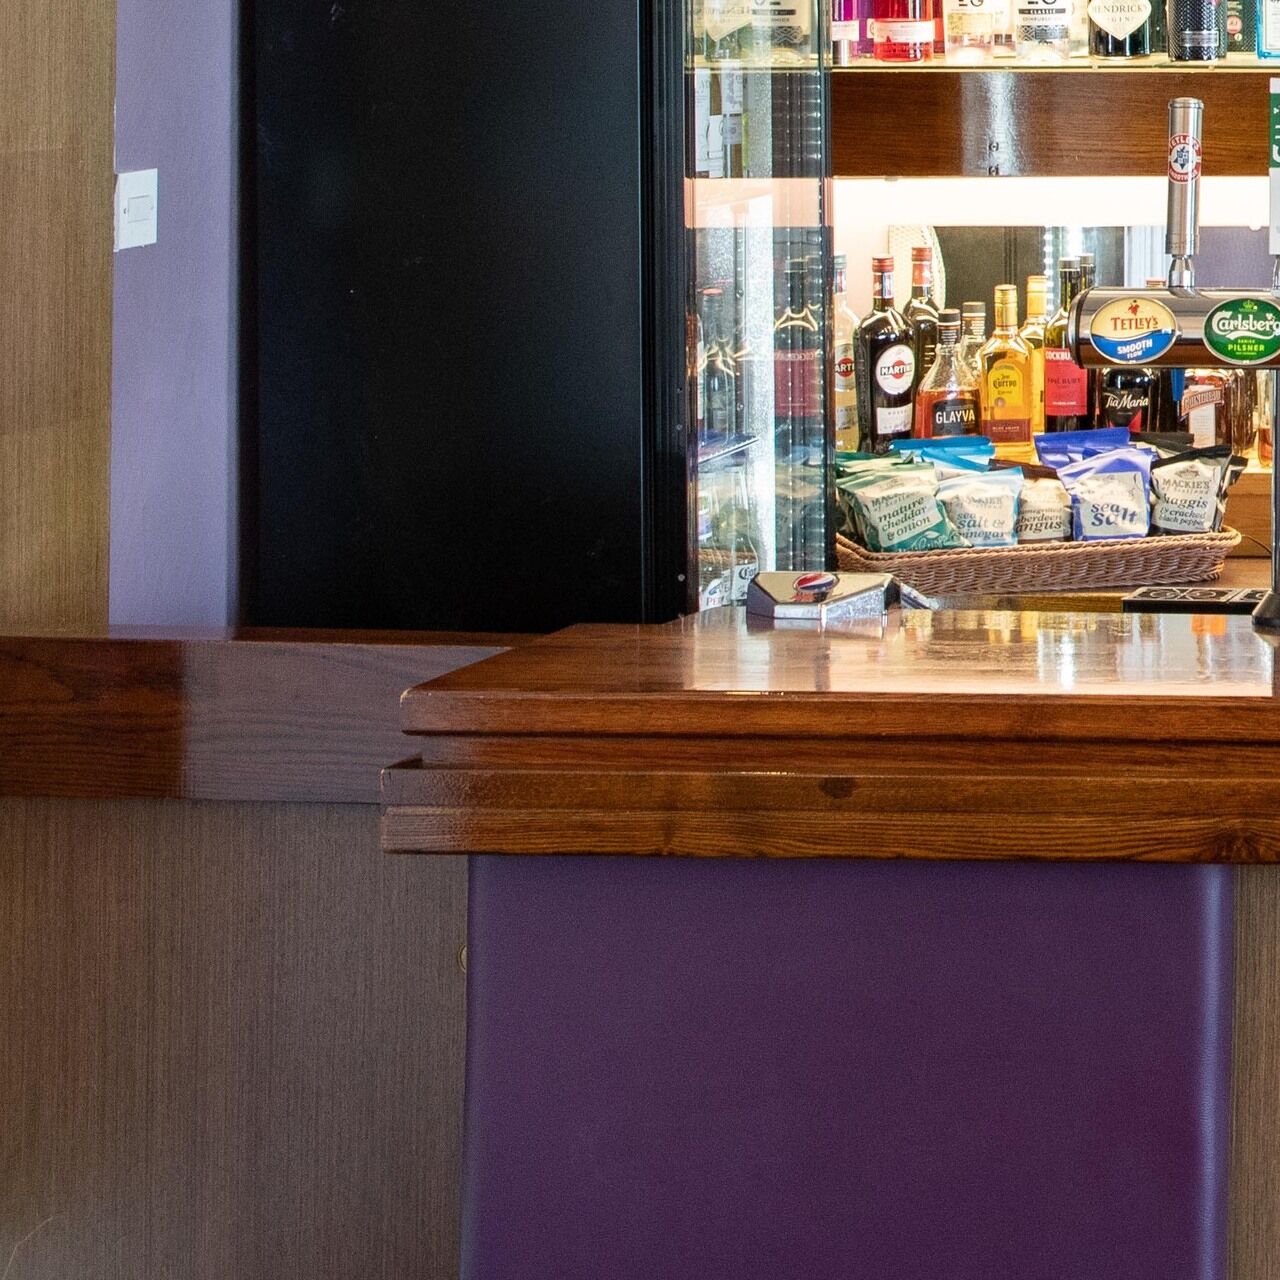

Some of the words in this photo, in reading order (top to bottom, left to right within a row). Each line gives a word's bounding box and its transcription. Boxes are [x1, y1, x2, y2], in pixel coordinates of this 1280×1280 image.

[1111, 315, 1158, 331] TETLEY'S
[1117, 339, 1152, 355] SMOOTH
[1228, 344, 1265, 352] PILSNER
[1127, 350, 1143, 359] FLOW
[834, 363, 855, 373] ARTI
[993, 379, 1017, 388] Cuervo
[1105, 394, 1119, 408] Tia
[1118, 394, 1150, 409] Maria
[935, 410, 976, 424] GLAYVA
[1163, 478, 1211, 489] MACKIE'S
[1163, 493, 1209, 509] haggis
[878, 496, 925, 523] mature
[1090, 503, 1120, 514] sea
[881, 505, 928, 532] cheddar
[957, 511, 976, 520] sea
[1020, 512, 1062, 523] berdeen
[1091, 506, 1138, 527] salt
[886, 531, 896, 541] &
[896, 516, 931, 537] onion
[957, 518, 987, 530] salt
[957, 531, 1006, 542] vinegar
